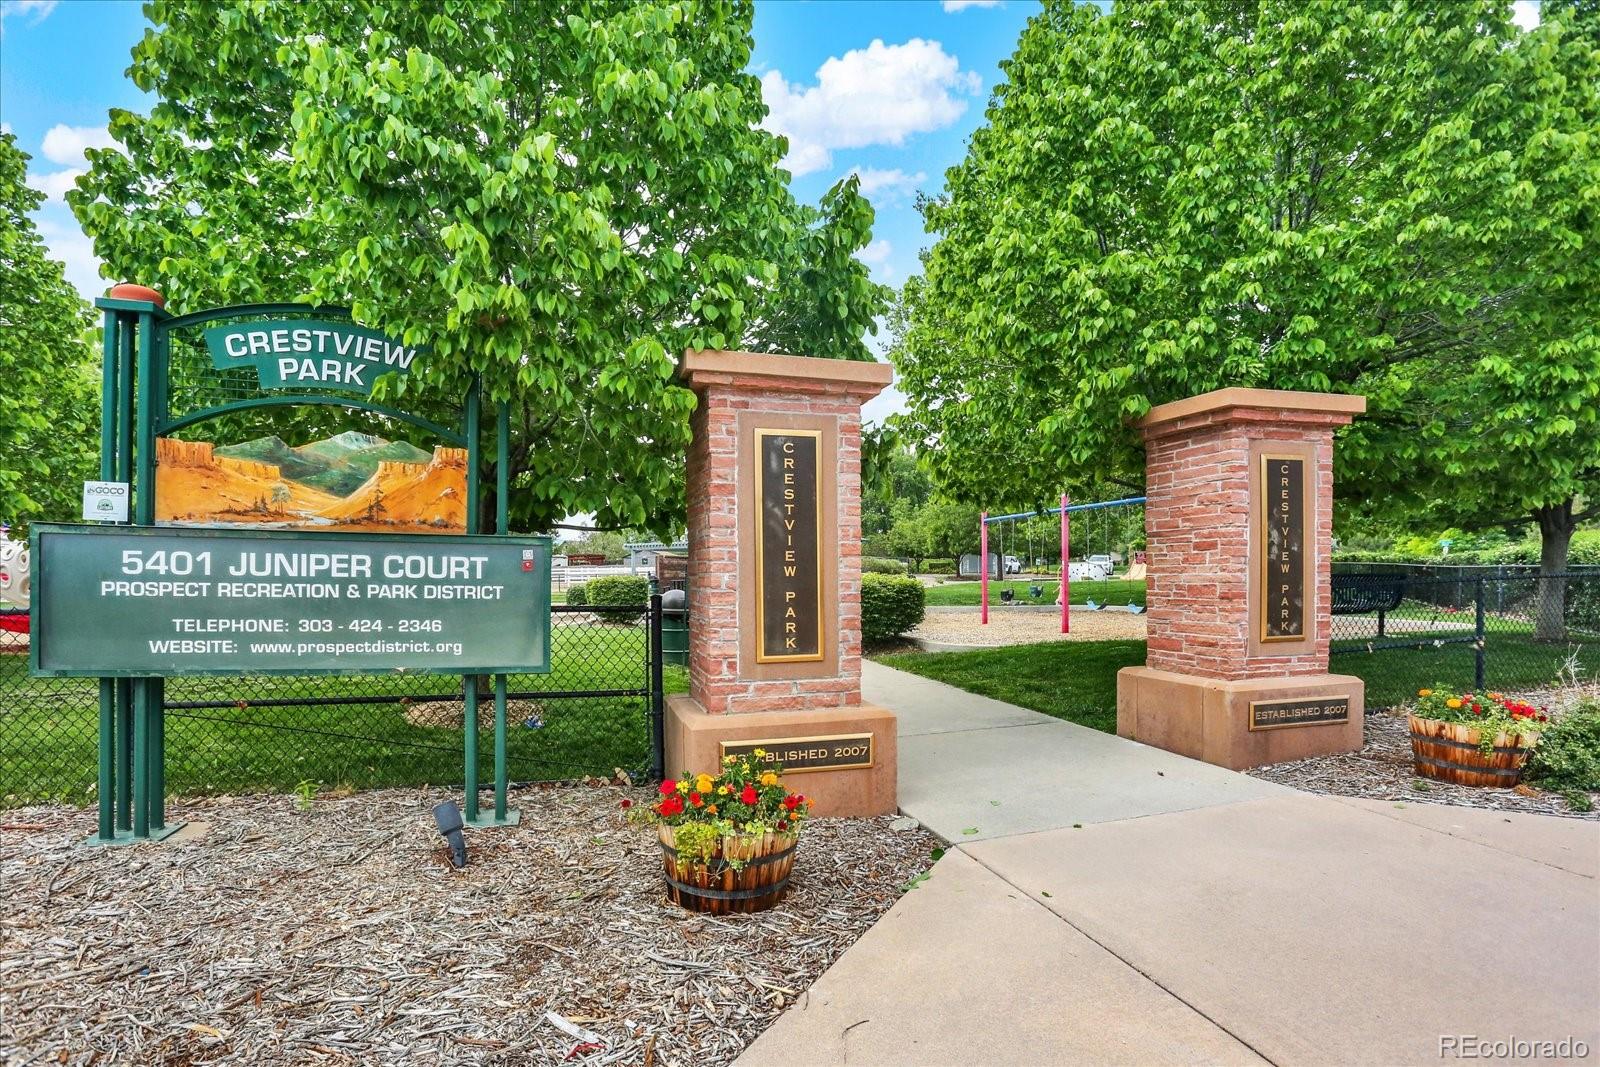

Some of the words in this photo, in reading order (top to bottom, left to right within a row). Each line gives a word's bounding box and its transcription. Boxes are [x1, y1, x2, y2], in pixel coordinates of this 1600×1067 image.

[225, 329, 416, 369] CRESTVIEW
[278, 358, 366, 386] PARK
[95, 486, 125, 495] GOCO
[783, 442, 797, 577] CRESTVIEW
[1280, 465, 1290, 574] CRESTVIEW
[121, 550, 211, 576] 5401
[229, 552, 372, 578] JUNIPER
[383, 555, 489, 579] COURT
[101, 581, 211, 597] PROSPECT
[217, 583, 340, 599] RECREATION
[346, 584, 361, 599] &
[367, 584, 418, 599] PARK
[423, 585, 504, 600] DISTRICT
[785, 591, 797, 649] PARK
[1281, 585, 1290, 631] PARK
[172, 619, 289, 633] TELEPHONE:
[298, 619, 333, 633] 303
[349, 619, 383, 633] 424
[398, 619, 442, 633] 2346
[149, 640, 238, 654] WEBSITE:
[250, 640, 463, 656] www.prospectdistrict.org
[1255, 706, 1321, 720] ESTABLISHED
[1324, 705, 1347, 715] 2007
[834, 746, 868, 758] 2007
